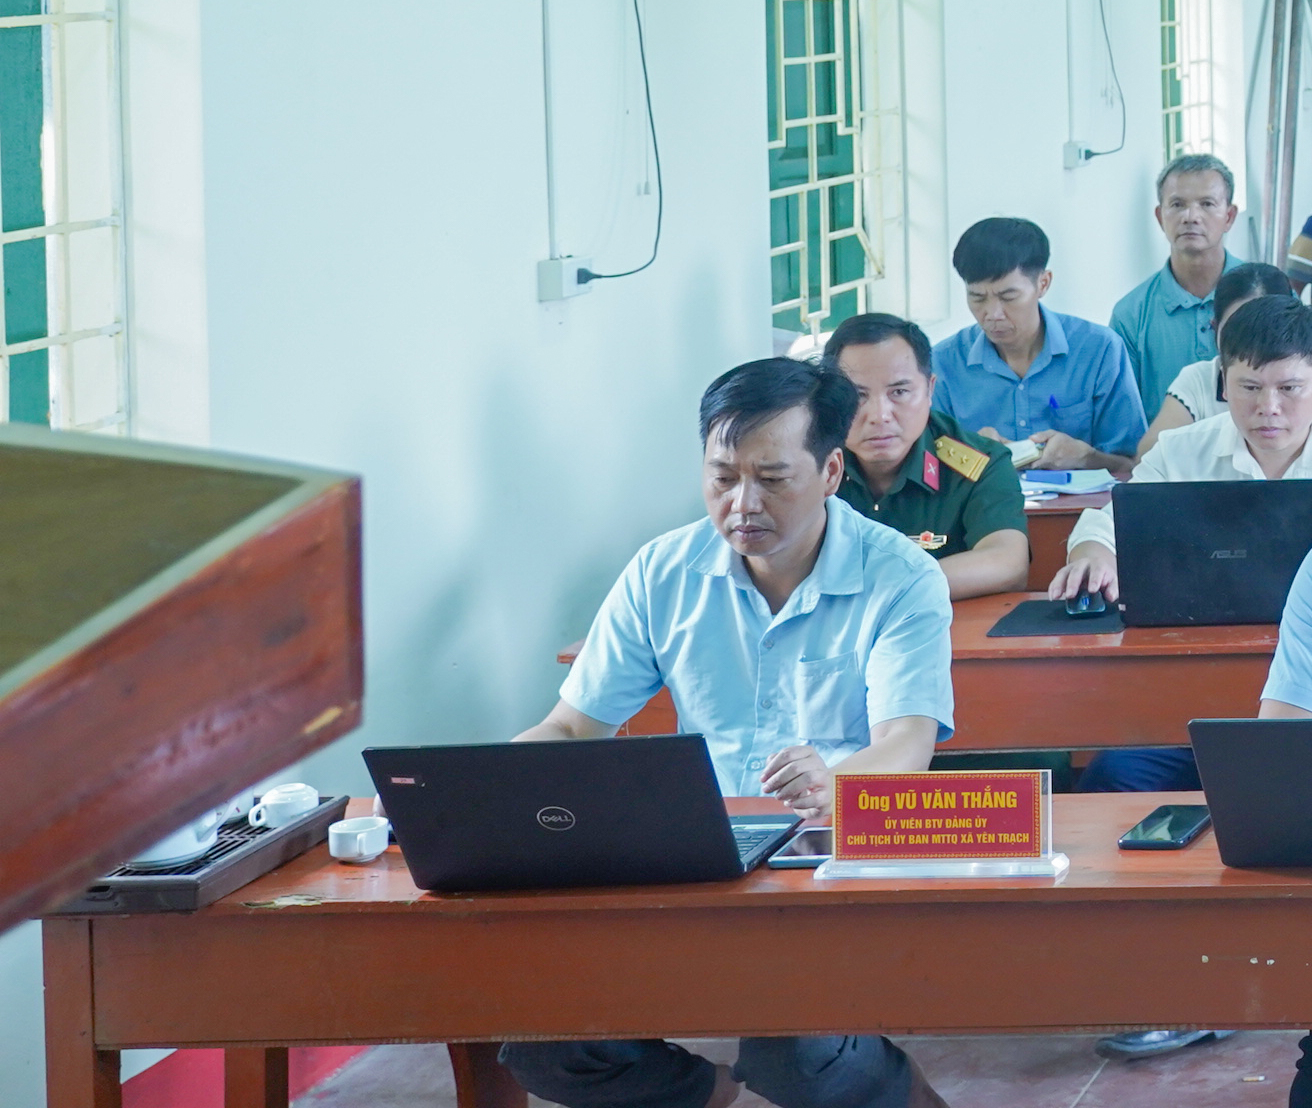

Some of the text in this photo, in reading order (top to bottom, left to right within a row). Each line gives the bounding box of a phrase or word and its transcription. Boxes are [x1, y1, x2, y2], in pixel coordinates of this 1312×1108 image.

[1210, 549, 1247, 559] ASUS
[858, 785, 1018, 811] Ông VŨ VĂN THẮNG
[542, 815, 572, 823] DELL
[885, 815, 988, 829] ỦY VIÊN BTV ĐẢNG ỦY
[847, 831, 1029, 847] CHỦ TỊCH ỦY BAN MTTQ XÃ YÊN TRẠCH
